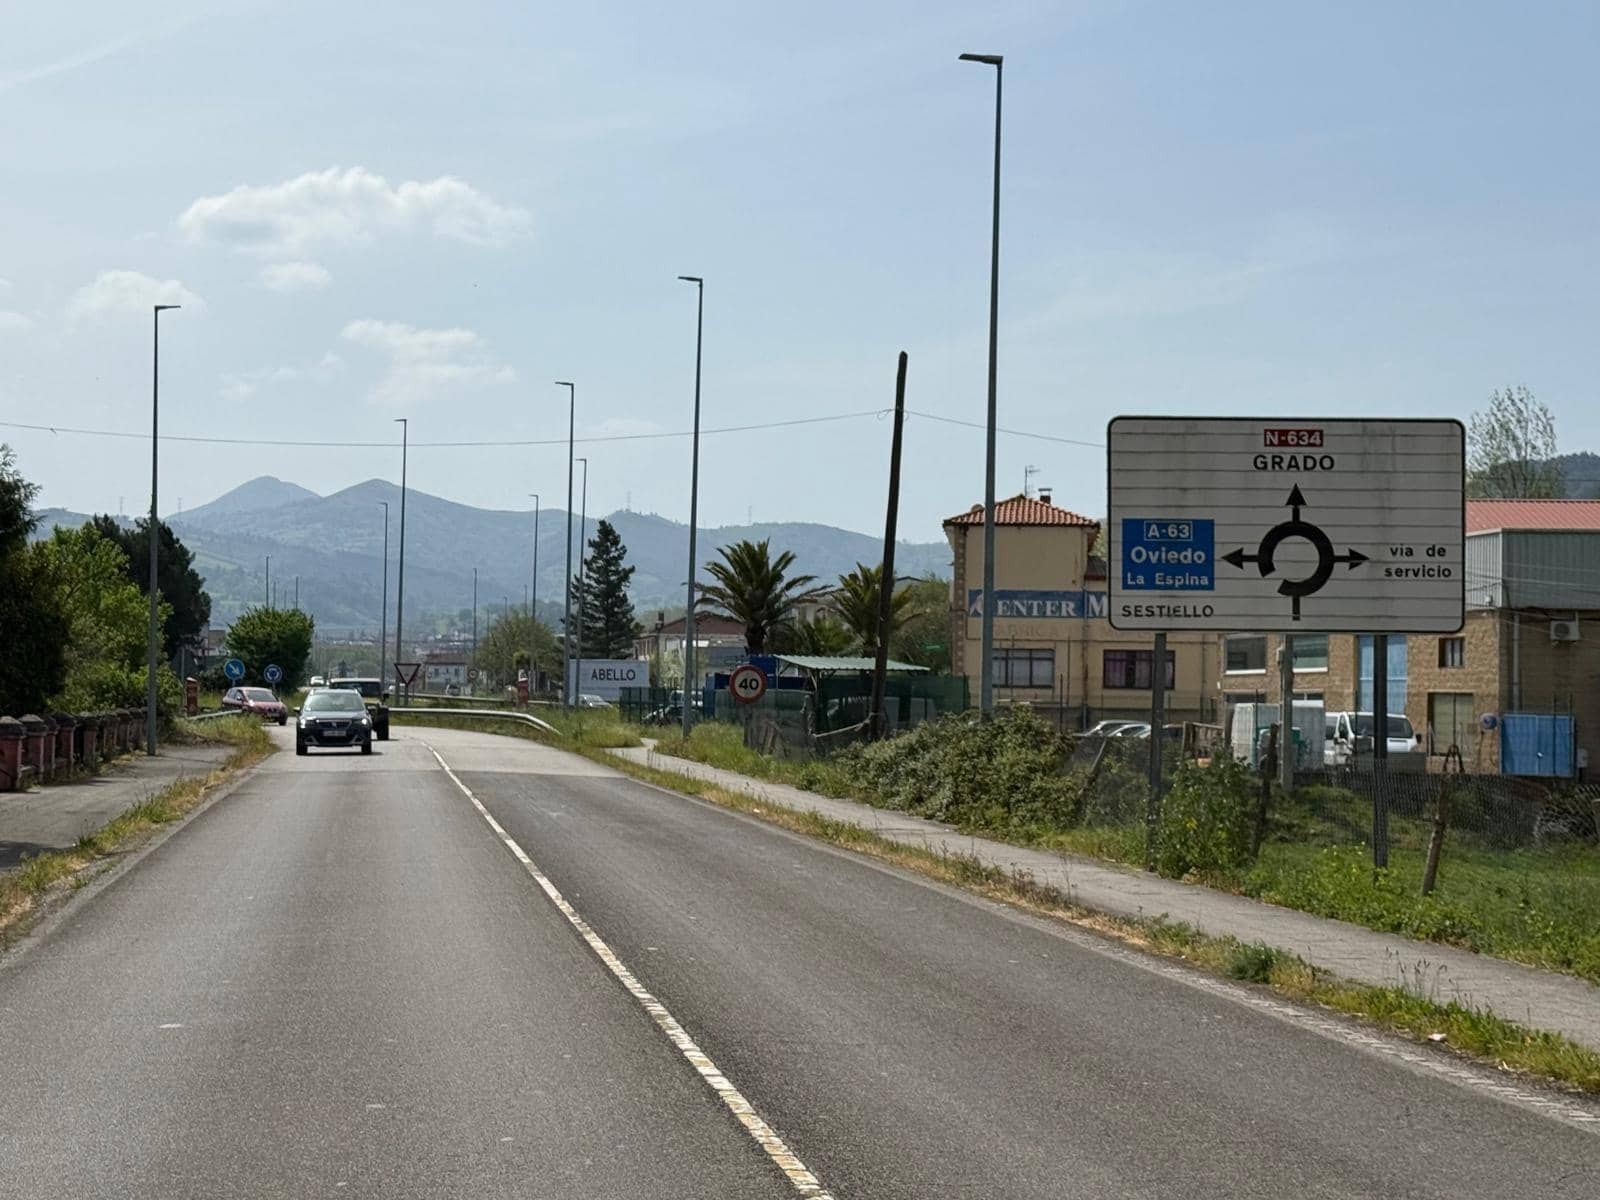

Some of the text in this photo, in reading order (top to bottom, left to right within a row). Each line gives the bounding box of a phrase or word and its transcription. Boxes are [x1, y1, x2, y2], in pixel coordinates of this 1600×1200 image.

[1265, 431, 1322, 446] N-634
[1253, 454, 1335, 471] GRADO
[1147, 524, 1190, 539] A-63
[1130, 545, 1206, 564] Oviedo
[1426, 543, 1447, 557] de
[1384, 564, 1452, 578] servicio
[1127, 572, 1209, 588] La Espina
[1121, 604, 1214, 618] SESTIELLO
[591, 668, 636, 682] ABELLO
[739, 677, 760, 691] 40
